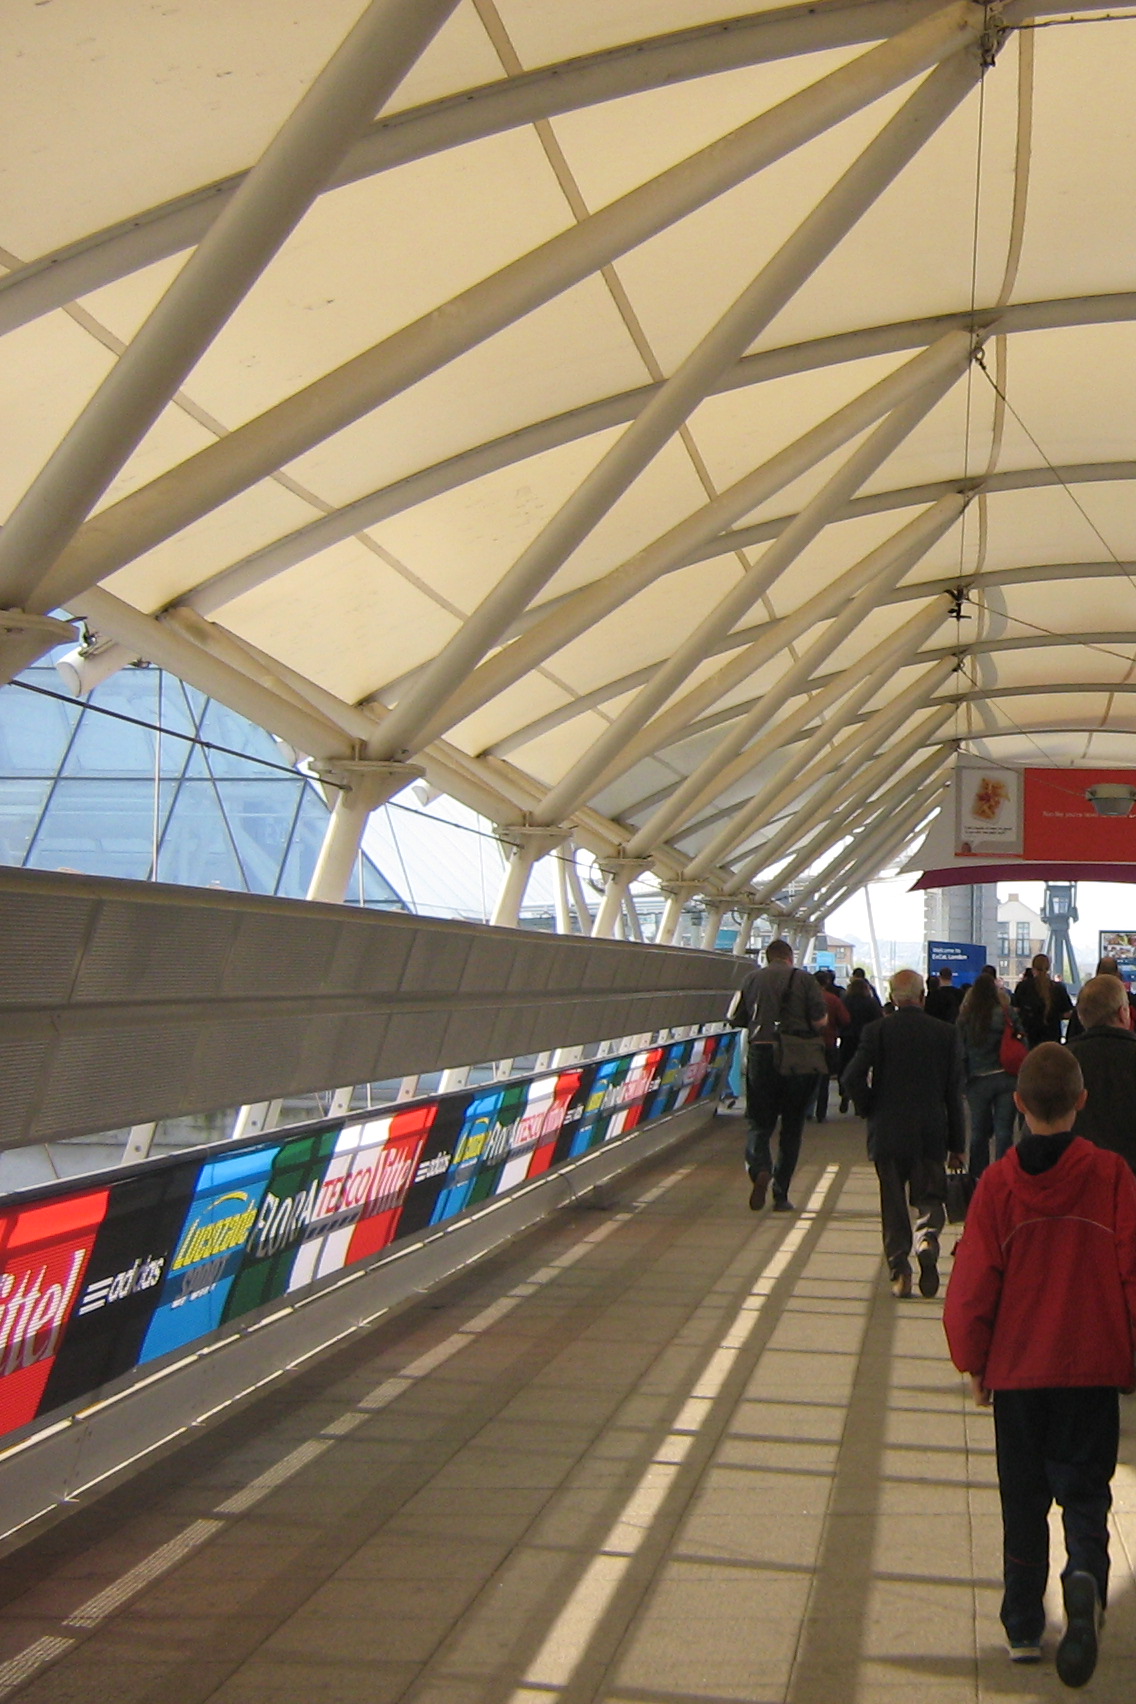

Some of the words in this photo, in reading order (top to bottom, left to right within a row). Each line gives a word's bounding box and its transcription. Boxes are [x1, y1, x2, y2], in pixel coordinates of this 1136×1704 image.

[316, 1166, 373, 1218] TESCO
[246, 1178, 319, 1259] FLORA
[108, 1254, 166, 1303] adidas
